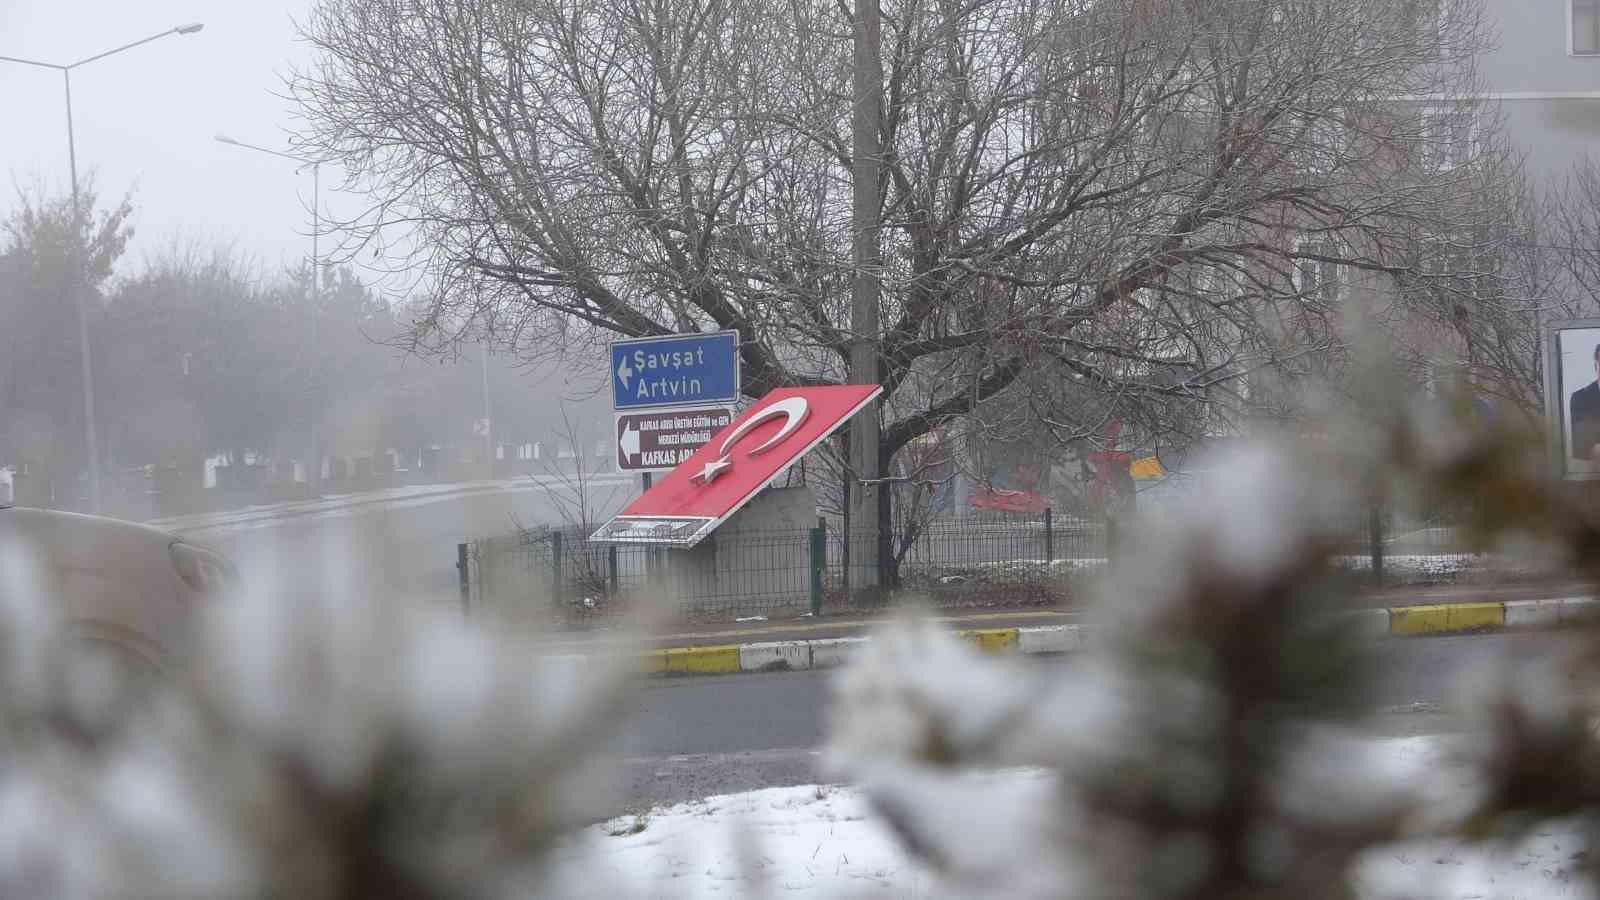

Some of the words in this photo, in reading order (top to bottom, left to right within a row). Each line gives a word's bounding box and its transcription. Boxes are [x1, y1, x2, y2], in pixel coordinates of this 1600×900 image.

[634, 346, 704, 373] Şavşat
[637, 376, 701, 399] Artvin
[640, 420, 659, 431] KAFKAS
[641, 450, 676, 466] KAFKAS
